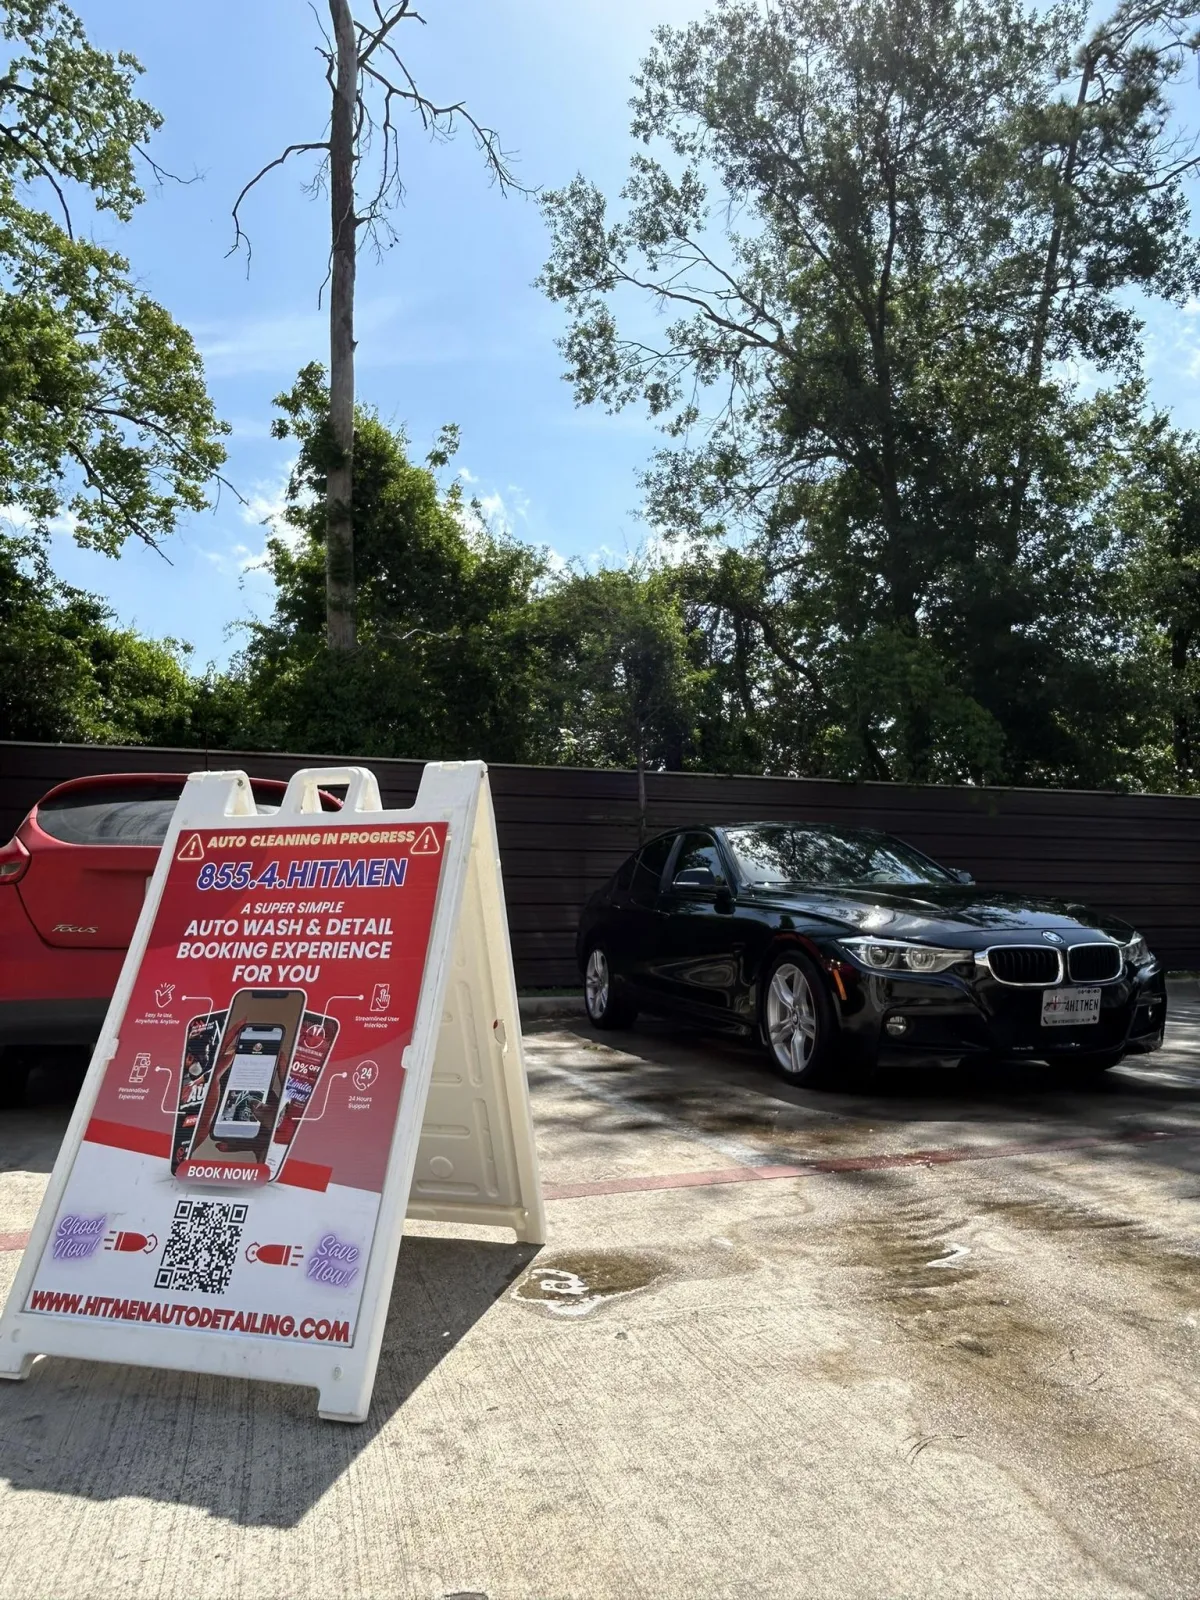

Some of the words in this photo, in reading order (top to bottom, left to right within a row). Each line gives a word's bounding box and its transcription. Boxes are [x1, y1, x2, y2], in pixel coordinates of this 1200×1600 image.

[207, 835, 247, 848] AUTO
[250, 833, 321, 847] CLEANING
[322, 832, 338, 845] IN
[339, 830, 416, 844] PROGRESS
[197, 858, 408, 890] 855.4.HITMEN
[241, 903, 251, 914] A
[253, 902, 294, 914] SUPER
[296, 901, 345, 914] SIMPLE
[184, 919, 239, 936] AUTO
[243, 919, 304, 936] WASH
[305, 919, 322, 936] &
[325, 918, 394, 935] DETAIL
[176, 942, 267, 959] BOOKING
[270, 941, 393, 959] EXPERIENCE
[232, 965, 273, 982] FOR
[277, 965, 320, 982] YOU
[160, 1018, 180, 1026] Anytime
[292, 1061, 308, 1074] 0%
[360, 1067, 372, 1080] 24
[187, 1082, 206, 1103] AU
[289, 1077, 312, 1092] Limite
[118, 1093, 145, 1101] Experience
[187, 1165, 221, 1179] BOOK
[223, 1167, 259, 1181] NOW!
[57, 1215, 106, 1237] Shoot
[53, 1237, 100, 1259] Now!
[316, 1235, 359, 1263] Save
[307, 1257, 358, 1288] Now!
[30, 1290, 350, 1343] WWW.HITMENAUTODETAILING.COM
